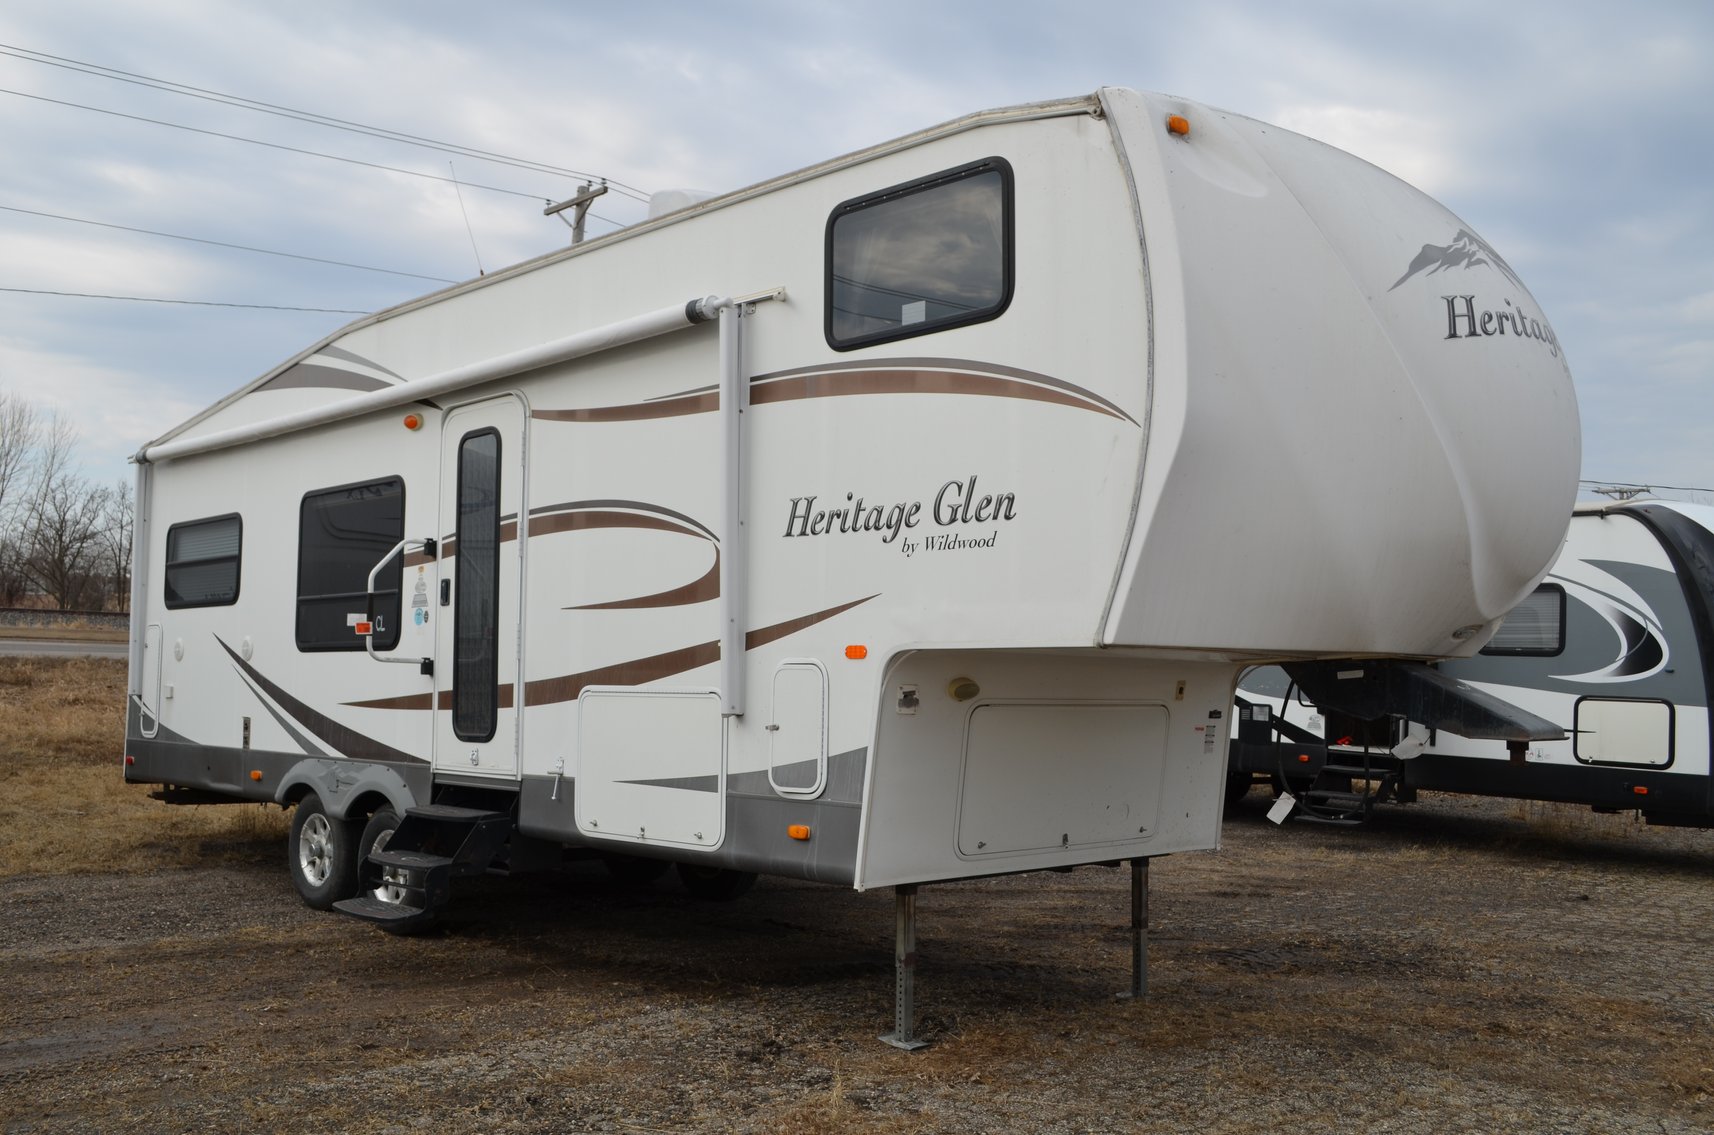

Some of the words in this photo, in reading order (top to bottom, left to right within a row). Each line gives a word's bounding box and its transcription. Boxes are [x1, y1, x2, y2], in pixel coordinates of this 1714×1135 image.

[1441, 295, 1561, 357] Heritag
[783, 492, 921, 543] Heritage
[933, 475, 1017, 526] Glen
[901, 537, 919, 557] by
[925, 531, 998, 551] Wildwood
